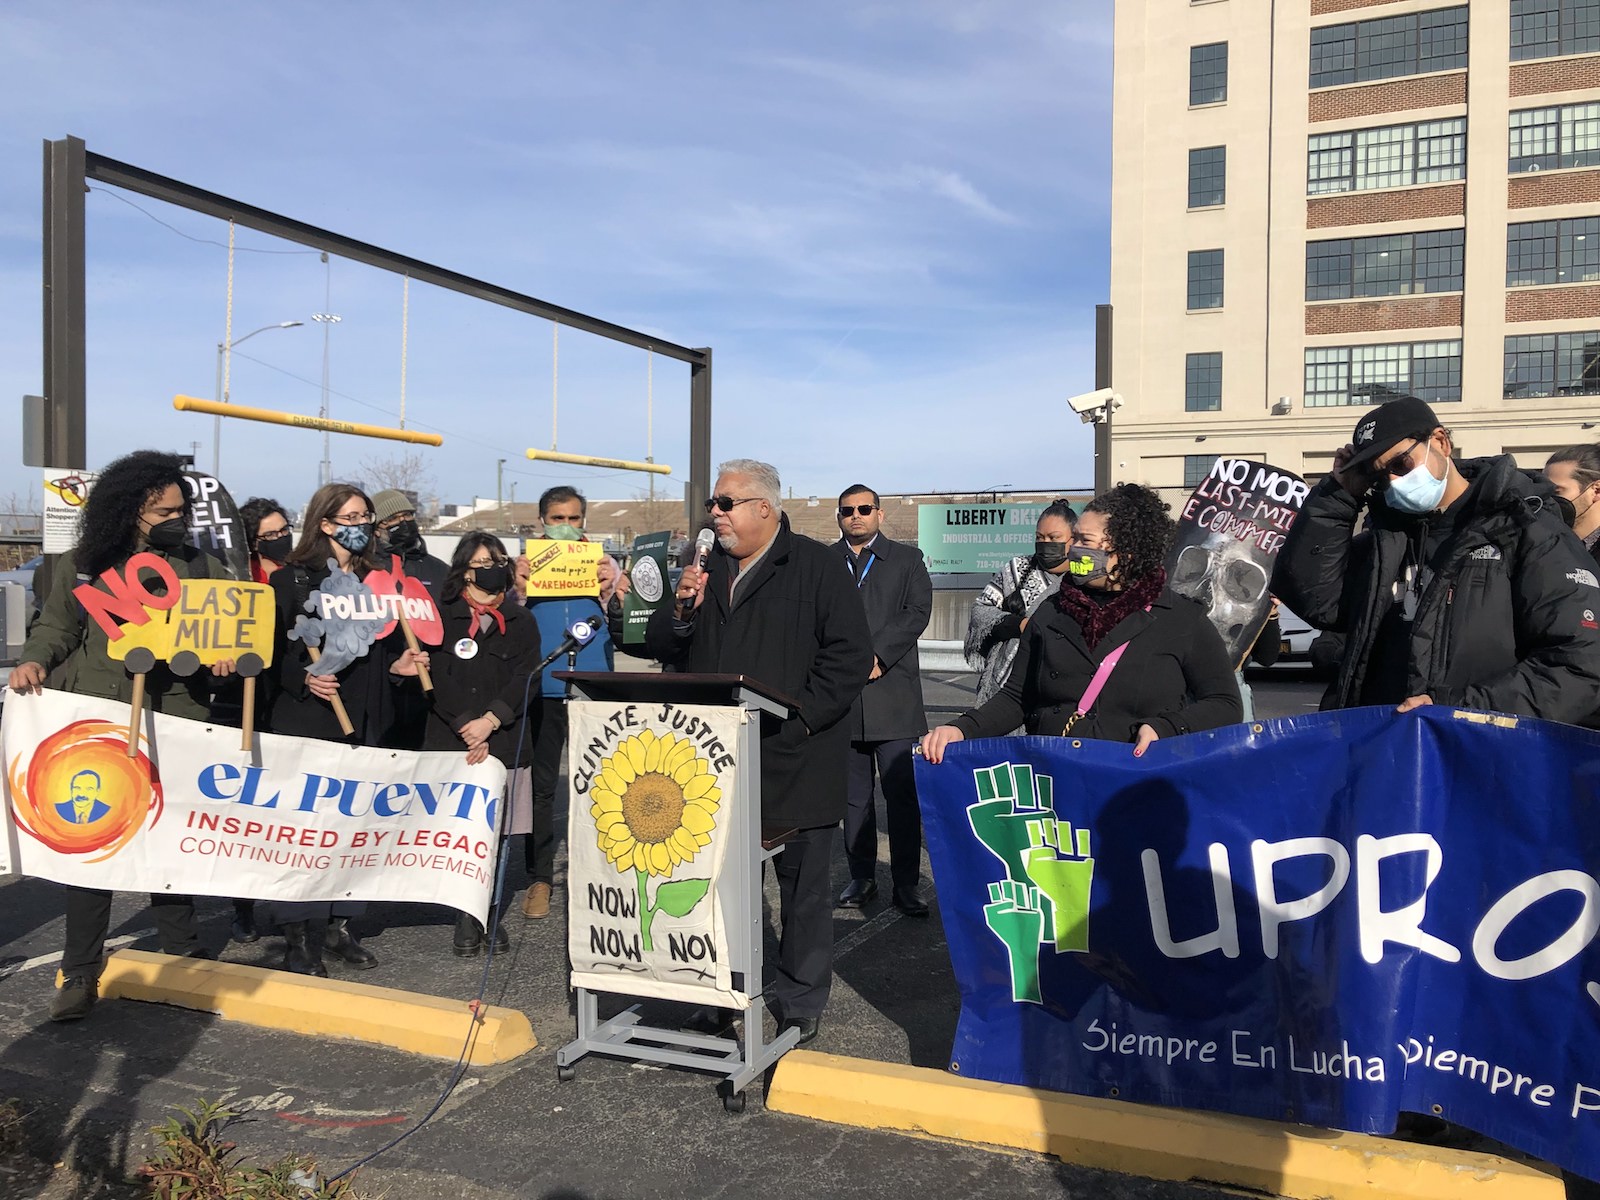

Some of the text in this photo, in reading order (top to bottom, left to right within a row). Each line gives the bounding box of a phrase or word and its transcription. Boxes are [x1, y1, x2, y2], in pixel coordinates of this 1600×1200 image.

[182, 475, 219, 502] OP
[1210, 457, 1311, 508] NO MOR
[191, 500, 233, 526] EL
[946, 509, 1007, 526] LIBERTY
[1197, 477, 1294, 530] LAST-MIL
[187, 525, 233, 549] TH
[942, 533, 1033, 544] INDUSTRIAL & OFFICE
[1198, 505, 1286, 554] COMMER
[568, 544, 588, 553] NOT
[72, 552, 181, 642] NO
[532, 579, 596, 590] WAREHOUSES
[180, 587, 264, 618] LAST
[320, 593, 435, 622] POLLUTION
[174, 619, 256, 648] MILE
[658, 703, 736, 774] JUSTICE
[186, 810, 490, 859] INSPIRED BY LEGAC
[179, 837, 331, 870] CONTINUING
[339, 853, 378, 869] THE
[588, 882, 636, 918] NOW
[1141, 832, 1600, 982] UPRO
[590, 925, 642, 962] NOW
[1082, 1018, 1386, 1082] Siempre En Lucha
